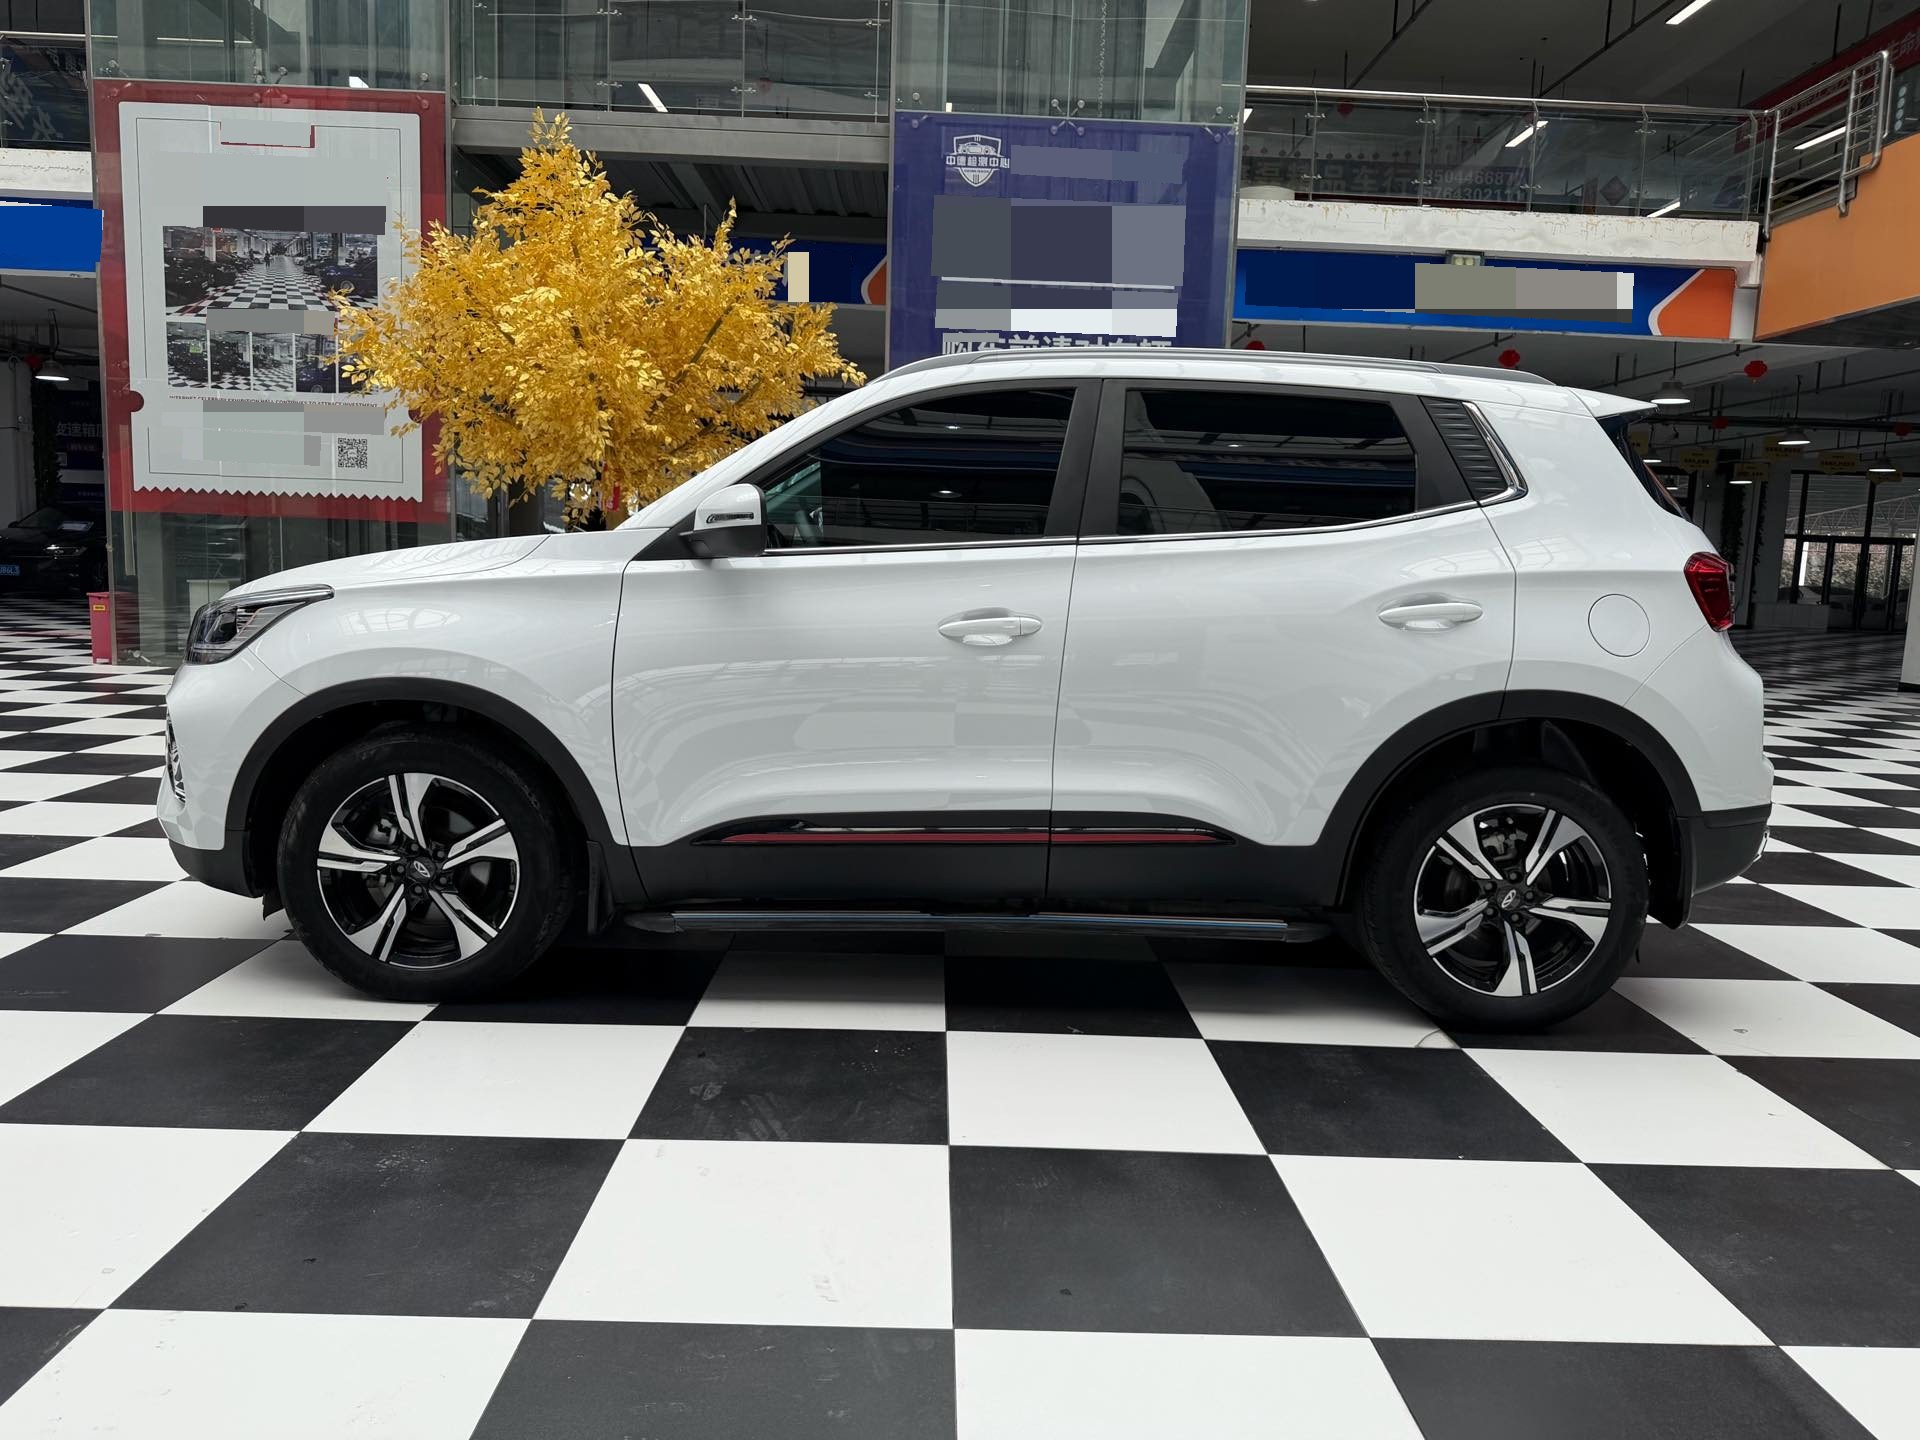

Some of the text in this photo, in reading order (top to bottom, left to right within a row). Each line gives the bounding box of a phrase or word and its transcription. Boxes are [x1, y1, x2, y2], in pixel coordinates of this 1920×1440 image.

[945, 155, 1010, 169] 中德检测中心
